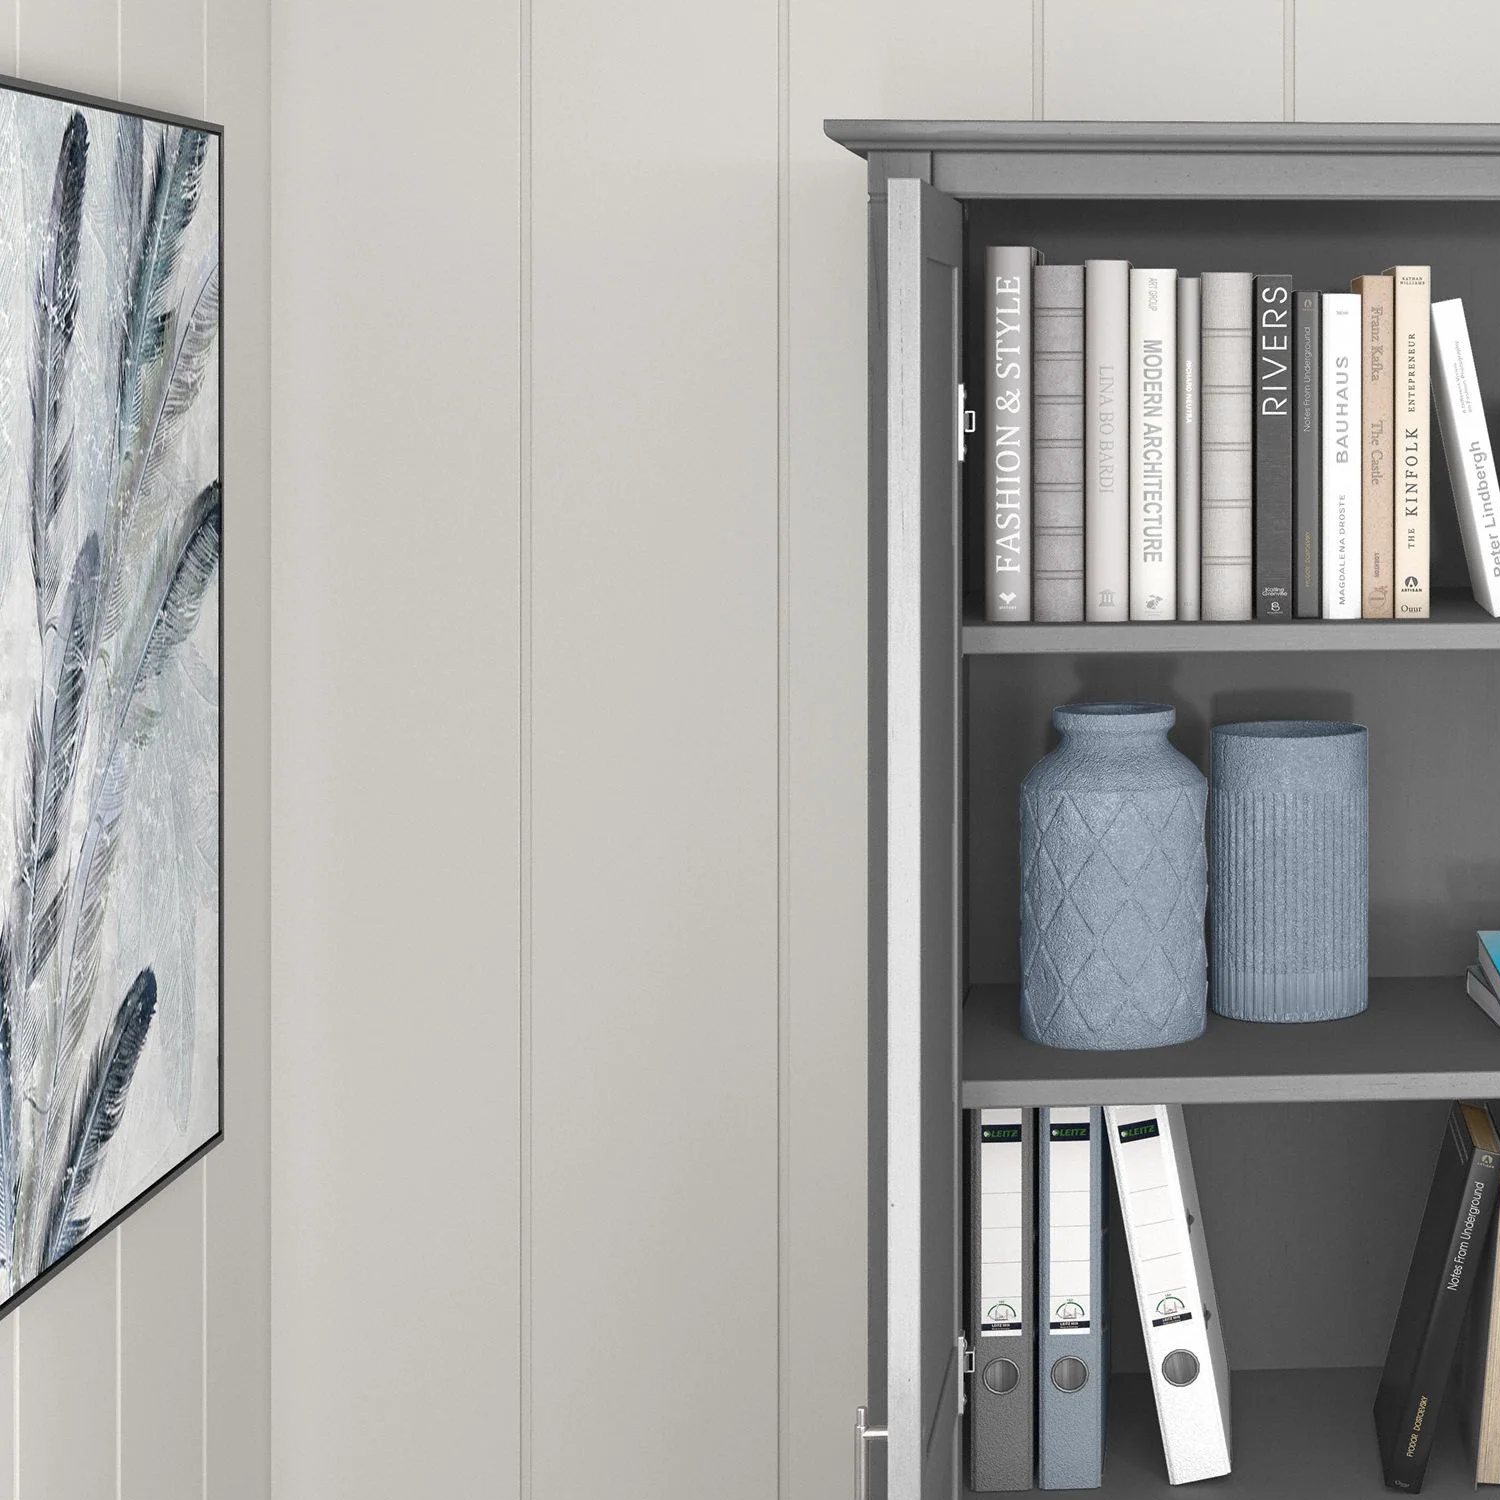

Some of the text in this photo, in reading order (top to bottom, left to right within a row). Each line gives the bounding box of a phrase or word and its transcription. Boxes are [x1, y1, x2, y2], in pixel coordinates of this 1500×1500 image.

[1149, 277, 1158, 311] ART GROUP
[1185, 360, 1193, 424] RICHARD NEUTRA
[1262, 286, 1288, 416] RIVERS
[1303, 327, 1312, 432] Notes From Underground
[1372, 306, 1382, 382] Franz Kafka
[996, 275, 1021, 573] FASHION & STYLE
[1099, 365, 1115, 493] LINA BO BARDI
[1143, 339, 1162, 563] MODERN ARCHITECTURE
[1336, 356, 1349, 463] BAUHAUS
[1372, 420, 1382, 486] The Castle
[1406, 333, 1418, 549] THE KINFOLK ENTEPRENEUR
[1469, 440, 1496, 529] Lindbergh
[1338, 494, 1346, 605] MAGDALENA DROSTE
[991, 1129, 1018, 1138] LEITZ
[1060, 1128, 1086, 1136] LEITZ
[1129, 1124, 1155, 1136] LEITZ
[1447, 1181, 1485, 1291] Notes From Underground
[1407, 1433, 1419, 1458] FYODOR
